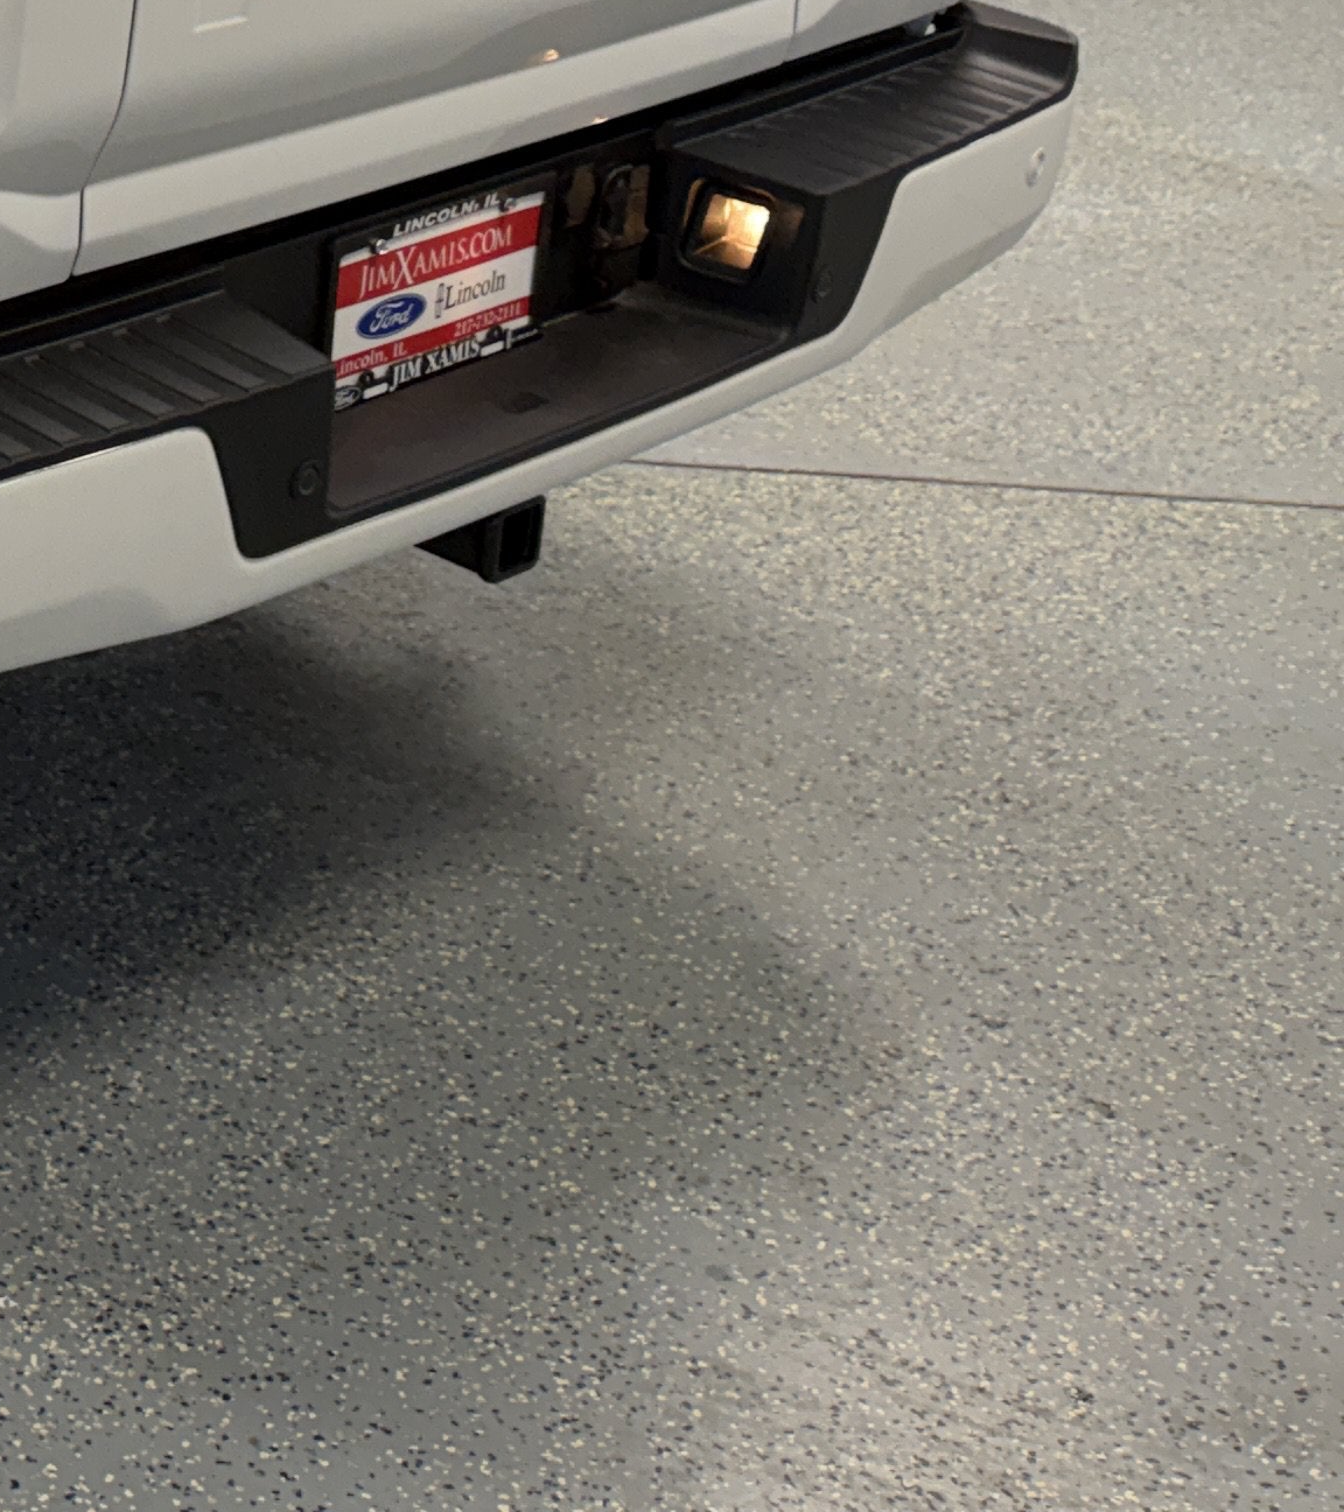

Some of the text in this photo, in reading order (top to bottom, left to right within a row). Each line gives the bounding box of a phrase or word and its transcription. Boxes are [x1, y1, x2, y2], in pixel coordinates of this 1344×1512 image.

[444, 270, 506, 310] Lincoln
[369, 300, 413, 334] Ford
[389, 338, 482, 393] JIM XAMIS
